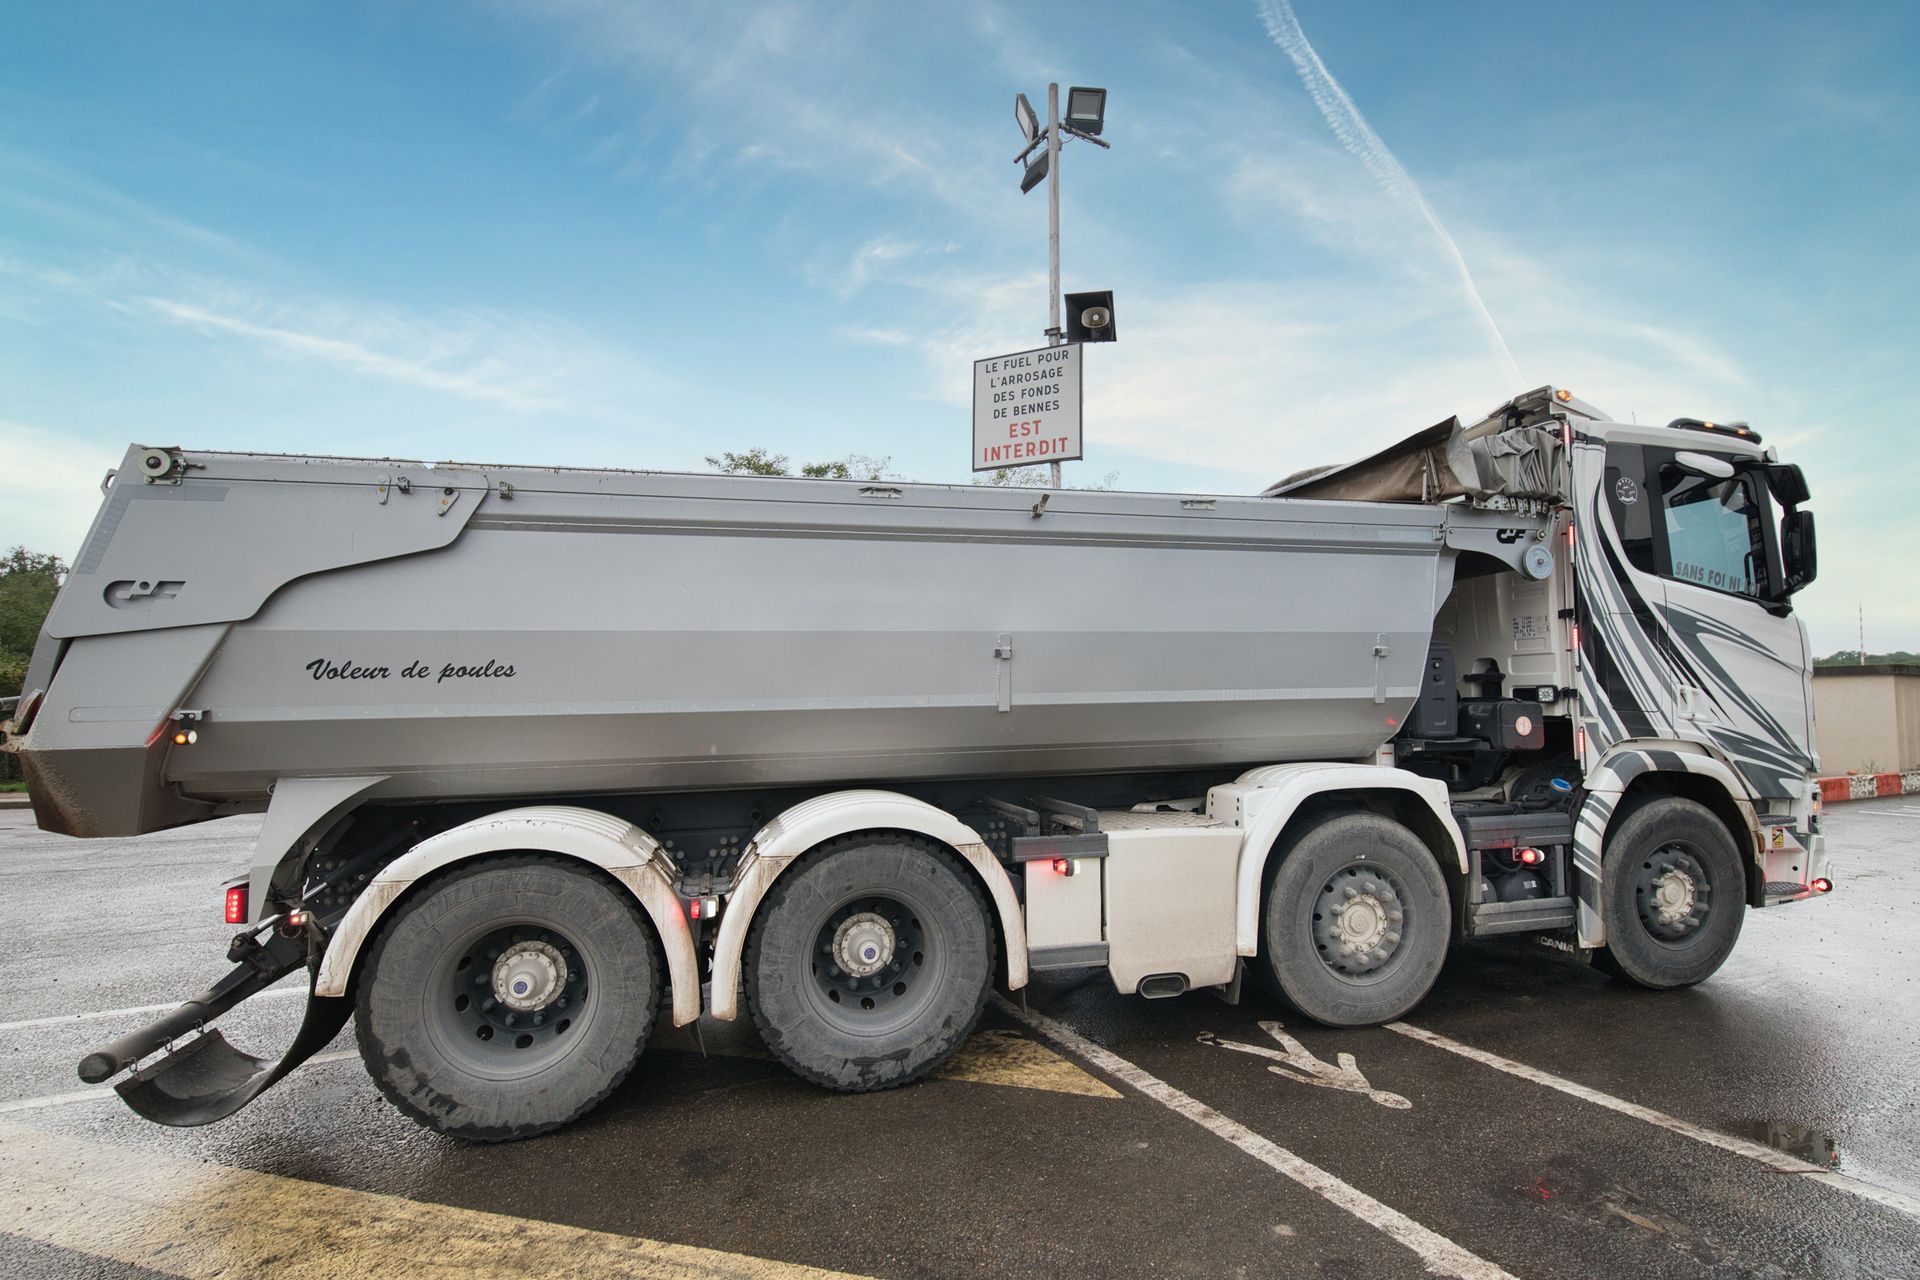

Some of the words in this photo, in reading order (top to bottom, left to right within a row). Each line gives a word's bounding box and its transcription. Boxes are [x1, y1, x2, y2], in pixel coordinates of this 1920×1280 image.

[985, 362, 998, 374] LE
[1004, 357, 1032, 371] FUEL
[1038, 350, 1069, 364] POUR
[990, 366, 1064, 388] L'ARROSAGE
[993, 391, 1015, 403] DES
[1021, 383, 1060, 399] FONDS
[993, 408, 1008, 419] DE
[1013, 400, 1060, 416] BENNES
[1009, 420, 1042, 438] EST
[983, 437, 1068, 462] INTERDIT
[1675, 561, 1704, 580] SANS
[1708, 569, 1726, 588] FOI
[1728, 575, 1741, 591] NI
[306, 658, 391, 680] Voleur
[401, 660, 430, 678] de
[437, 659, 517, 684] poules
